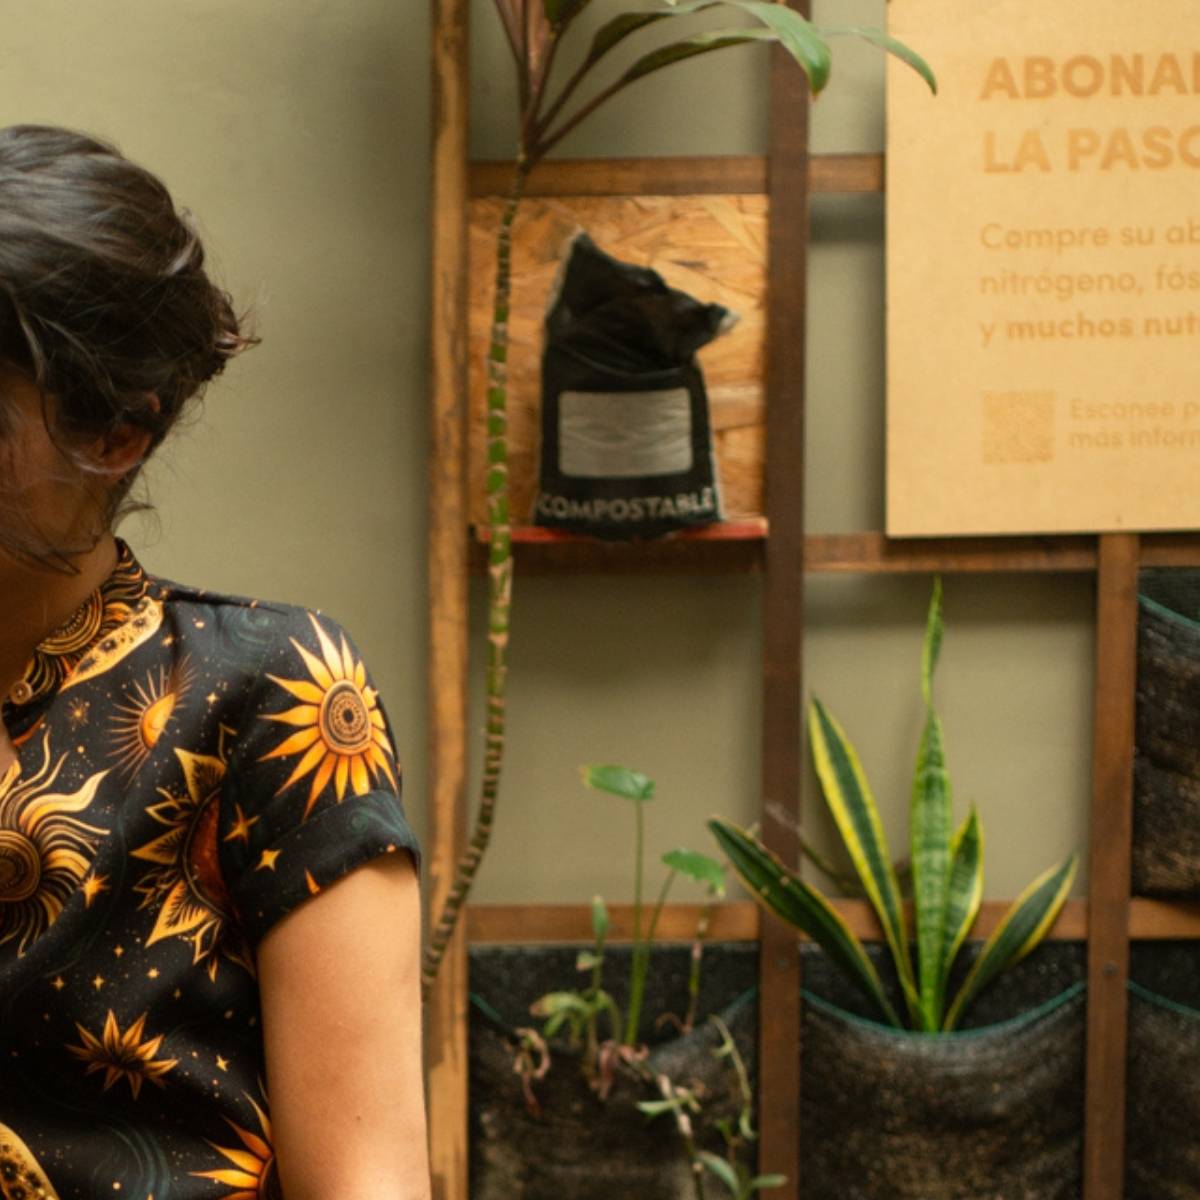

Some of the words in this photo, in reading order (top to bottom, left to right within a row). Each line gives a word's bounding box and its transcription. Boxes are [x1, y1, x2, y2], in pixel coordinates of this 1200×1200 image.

[979, 52, 1200, 101] ABONA
[983, 129, 1052, 173] LA
[979, 222, 1109, 255] Compre
[1120, 225, 1154, 246] su
[979, 268, 1144, 302] nitrógeno,
[979, 318, 996, 349] y
[1006, 311, 1134, 340] muchos
[537, 488, 713, 522] COMPOSTABLE
